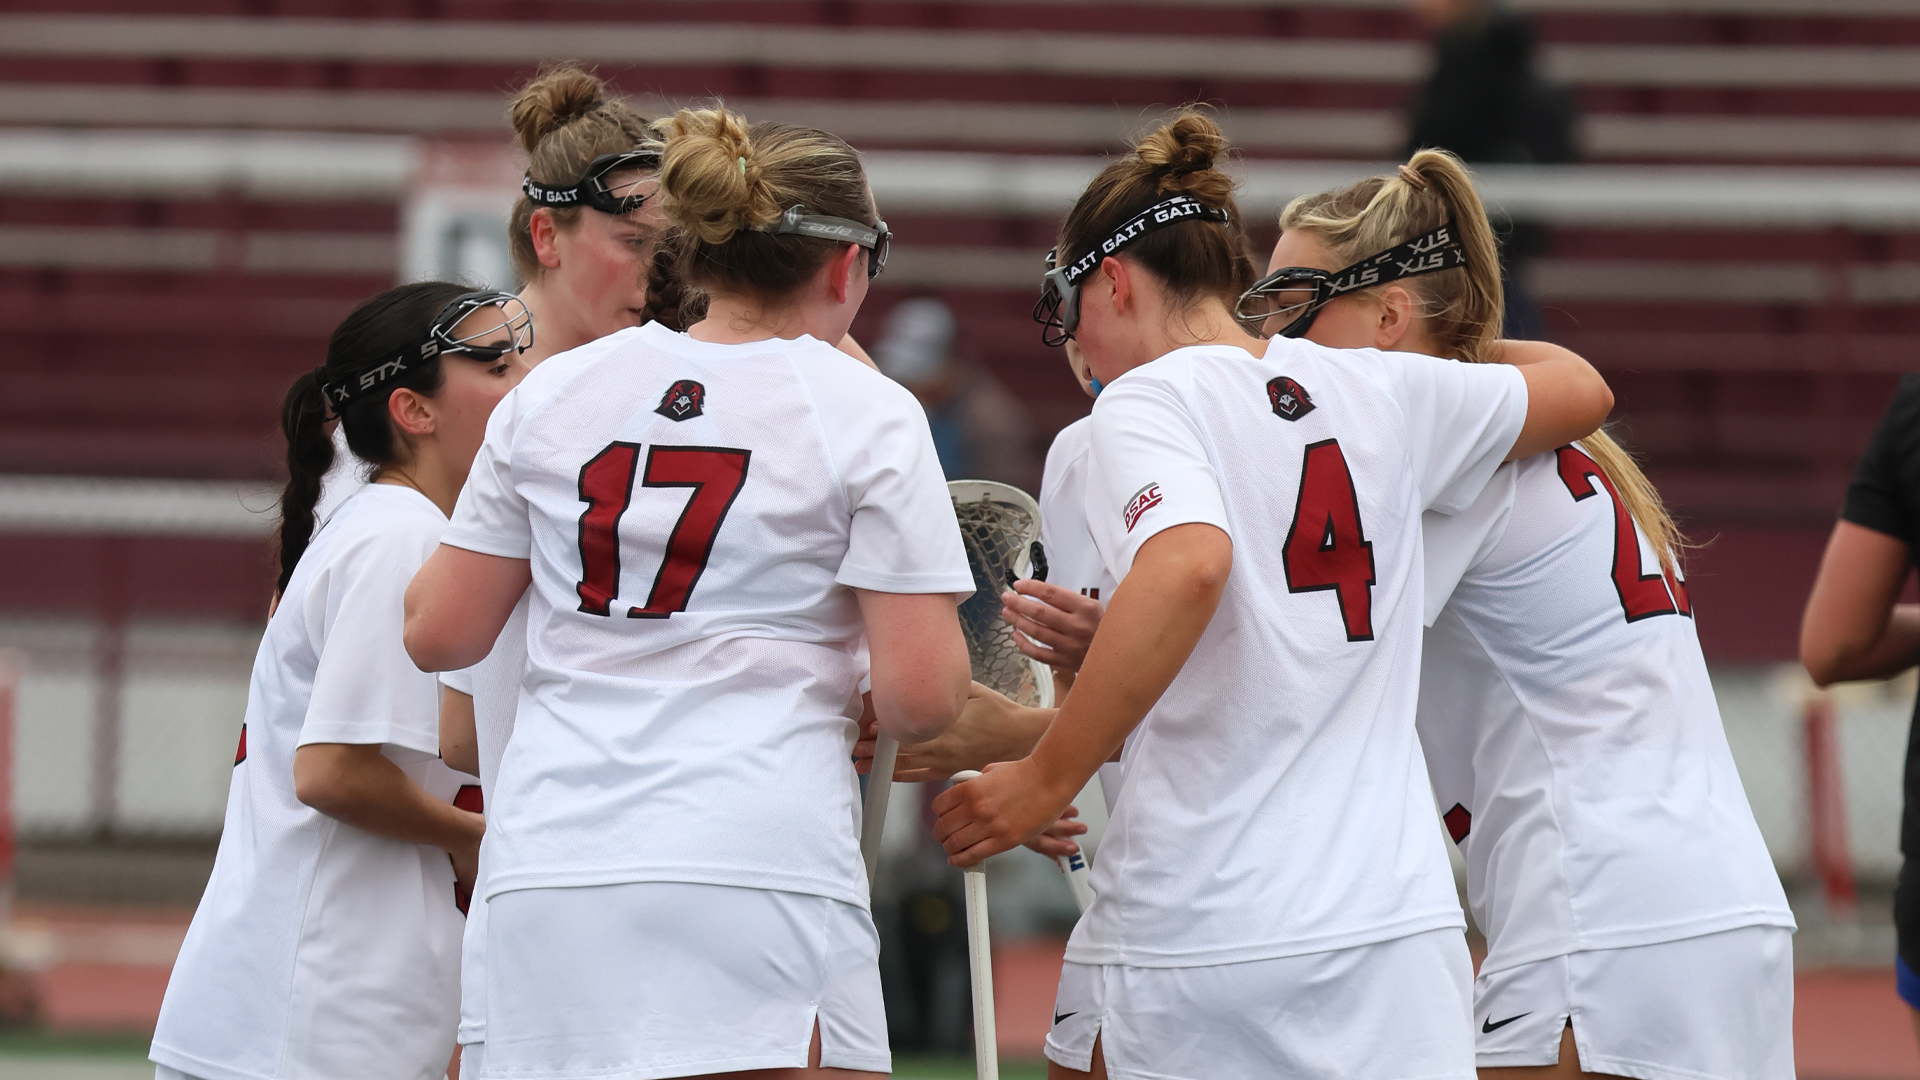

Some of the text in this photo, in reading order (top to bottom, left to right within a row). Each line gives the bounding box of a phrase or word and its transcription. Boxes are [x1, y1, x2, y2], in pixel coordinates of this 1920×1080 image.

[546, 188, 578, 202] GAIT
[1102, 219, 1145, 254] GAIT
[1154, 203, 1202, 224] GAIT
[1407, 228, 1450, 255] STX
[1324, 267, 1379, 296] STX
[1396, 252, 1443, 277] STX
[359, 356, 407, 391] STX
[1124, 485, 1162, 529] PSAC
[576, 440, 752, 619] 17
[1281, 437, 1377, 642] 4
[1555, 444, 1693, 624] 2
